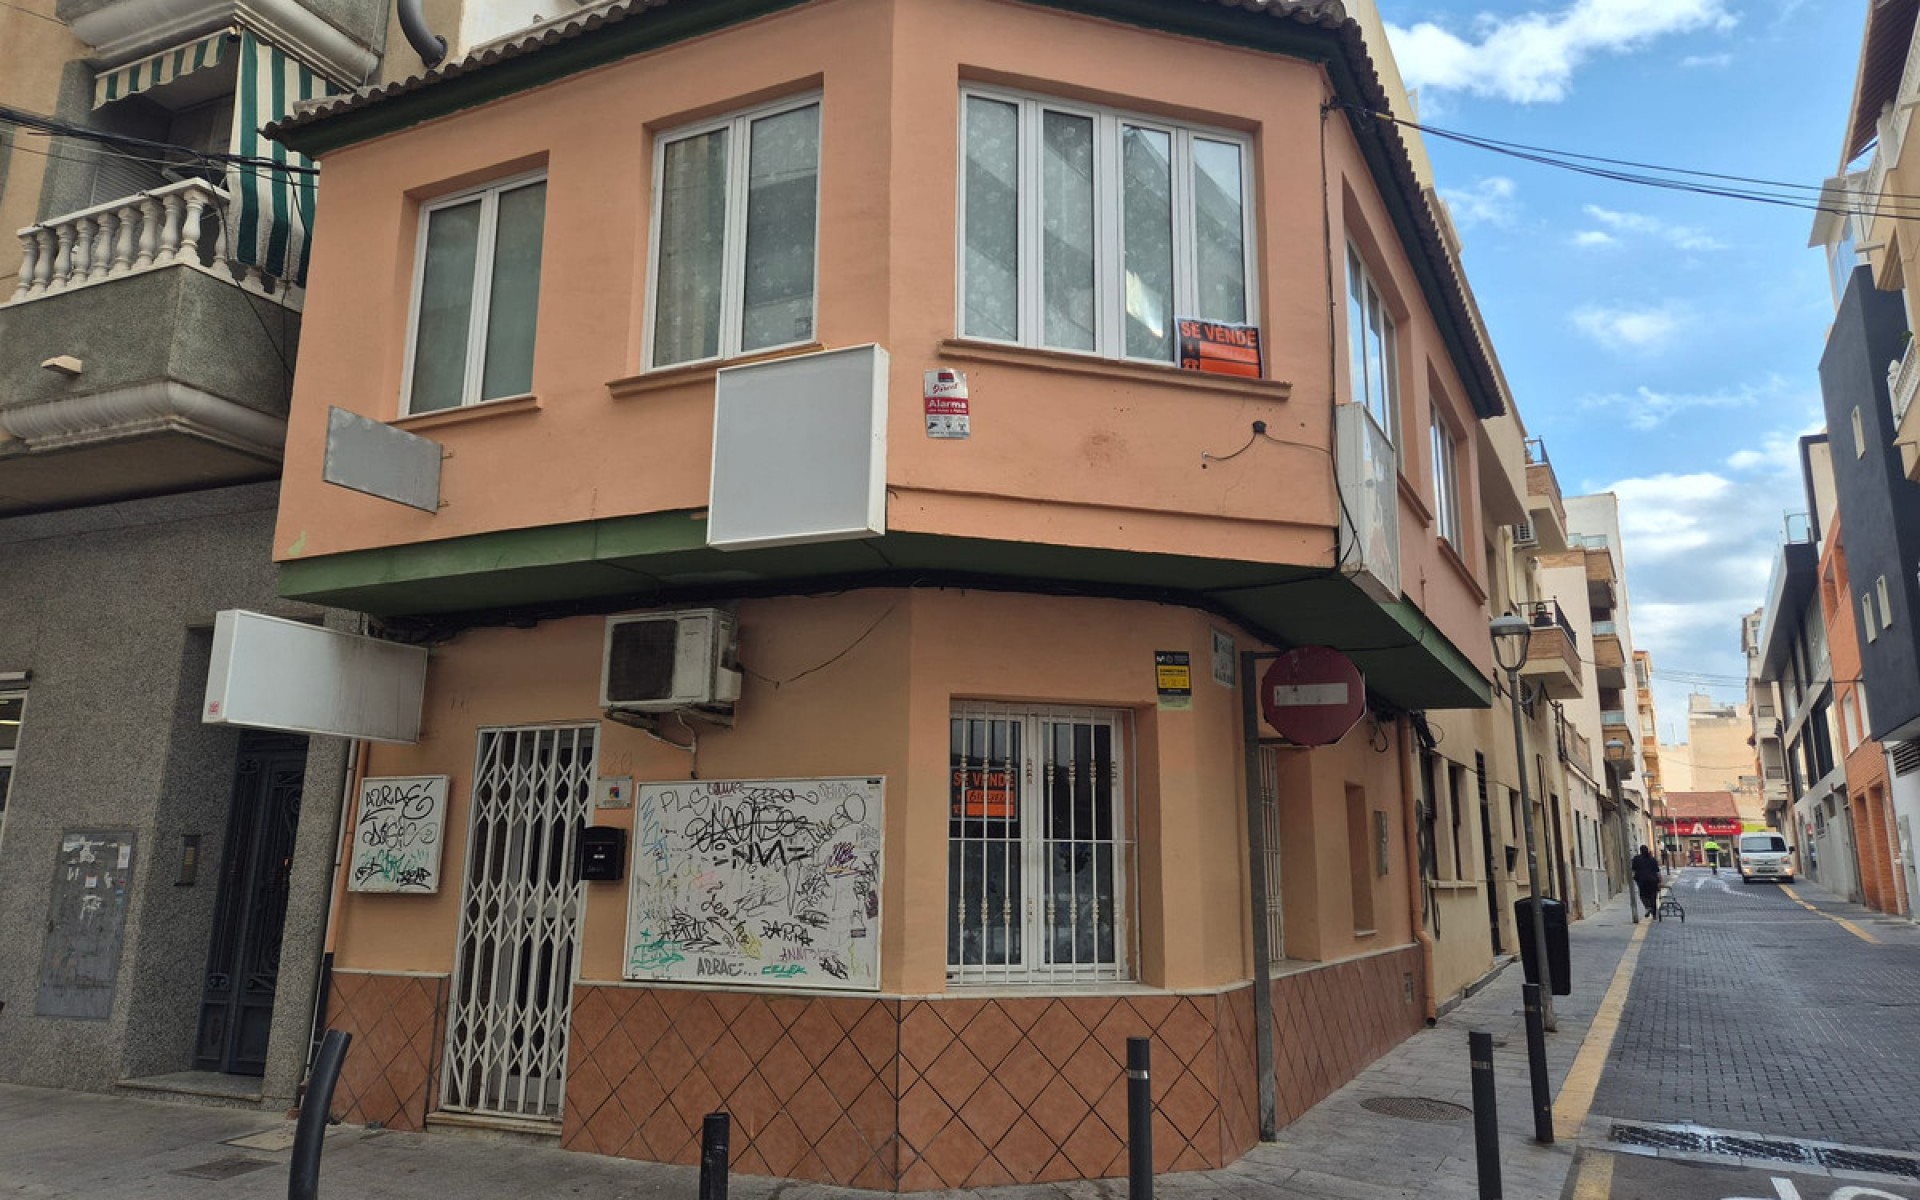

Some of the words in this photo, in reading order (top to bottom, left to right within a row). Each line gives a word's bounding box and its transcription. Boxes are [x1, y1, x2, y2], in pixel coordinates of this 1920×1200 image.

[1180, 321, 1201, 339] SE
[1204, 325, 1257, 347] VENDE
[928, 399, 967, 409] Alarma
[972, 772, 1014, 787] VNDE
